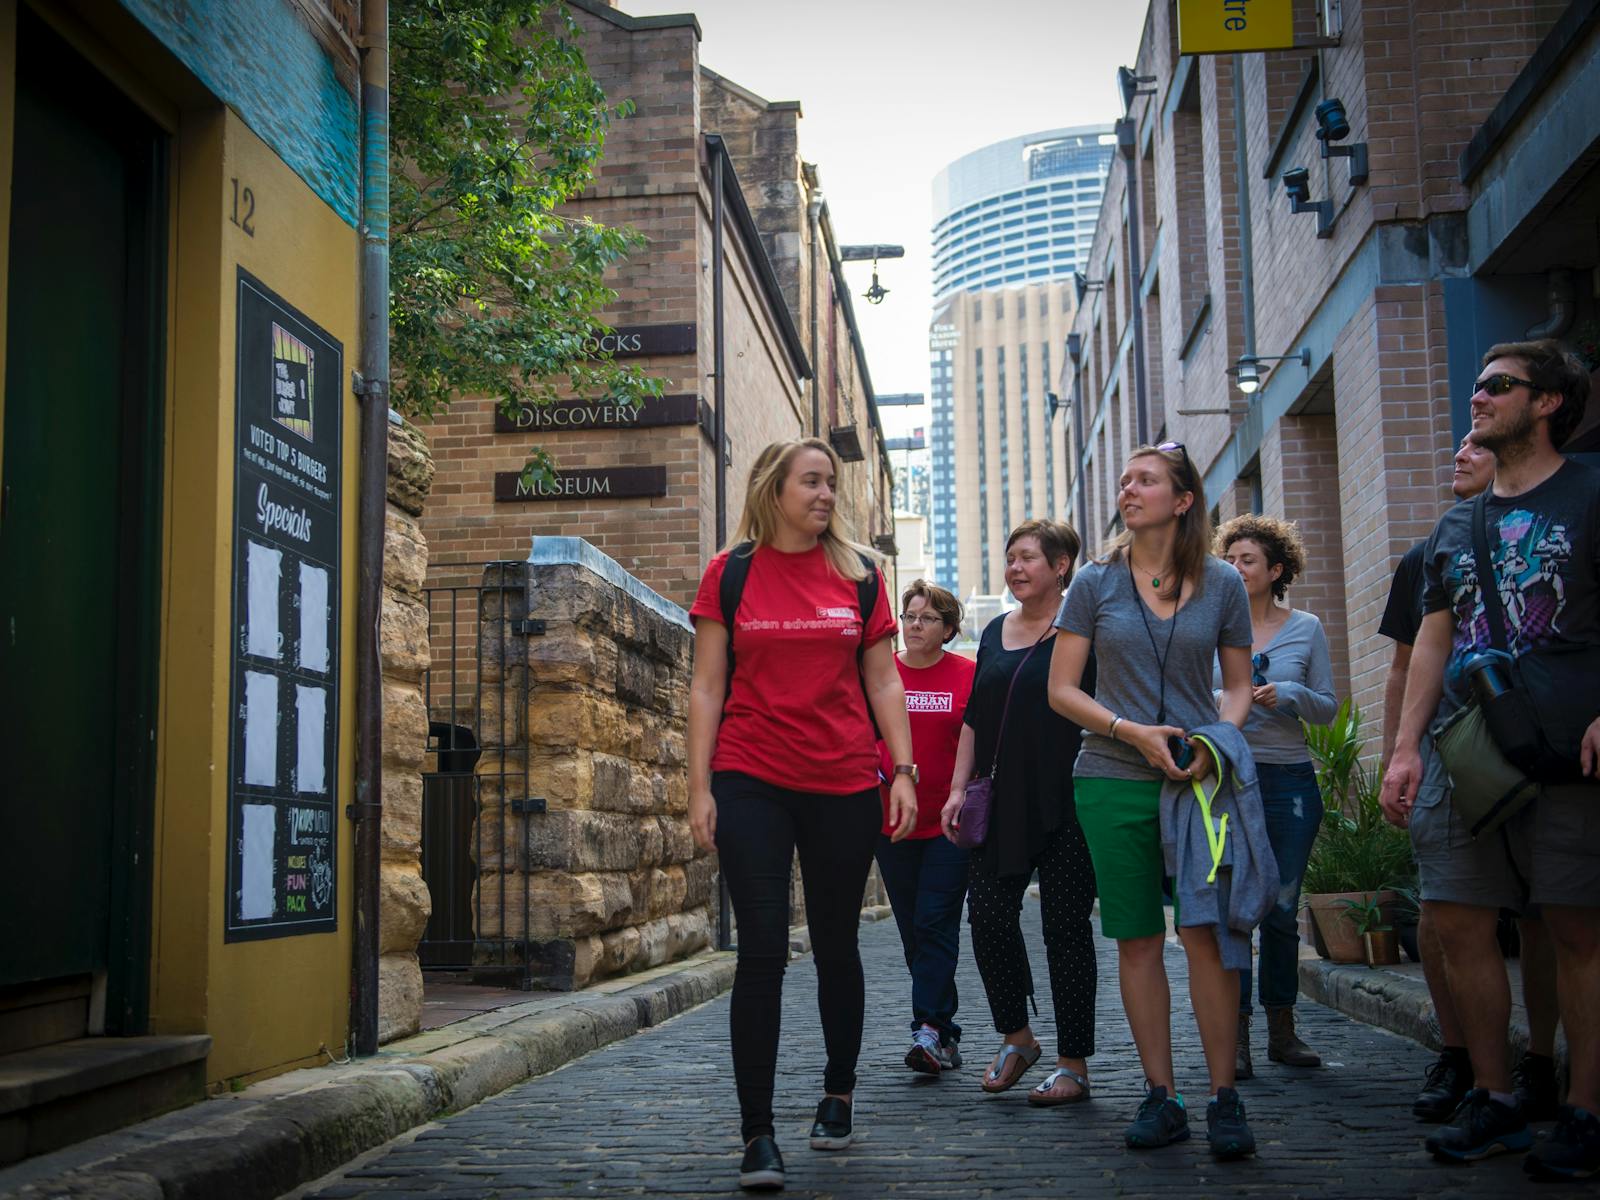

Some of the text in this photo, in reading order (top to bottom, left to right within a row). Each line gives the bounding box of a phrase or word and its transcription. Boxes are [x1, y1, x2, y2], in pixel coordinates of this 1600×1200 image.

[229, 177, 255, 238] 12
[583, 334, 641, 353] OCKS
[516, 405, 641, 428] DISCOVERY
[251, 424, 274, 454] VOTED
[276, 439, 289, 462] TOP
[290, 447, 297, 466] 5
[298, 451, 327, 483] BURGERS
[515, 476, 610, 496] MUSEUM
[257, 482, 312, 543] Specials
[287, 874, 306, 891] FUN
[287, 895, 306, 912] PACK
